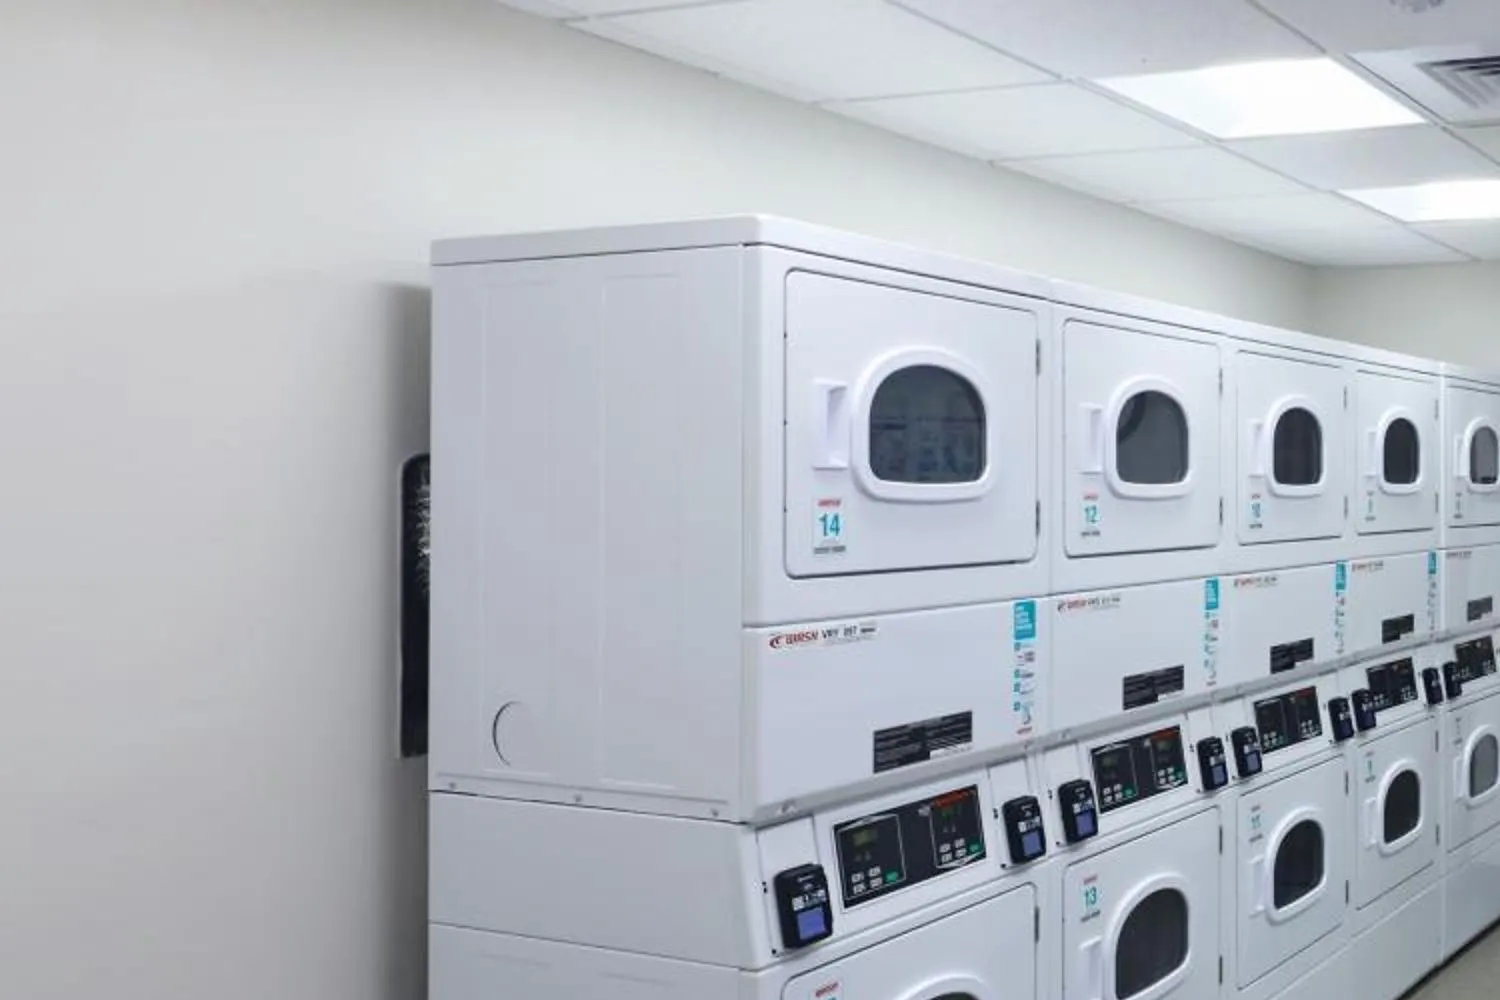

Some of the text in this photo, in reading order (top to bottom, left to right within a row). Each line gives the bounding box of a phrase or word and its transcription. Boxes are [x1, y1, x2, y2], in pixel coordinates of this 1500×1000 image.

[819, 512, 841, 537] 14
[1084, 504, 1097, 523] 12
[1084, 886, 1098, 908] 13
